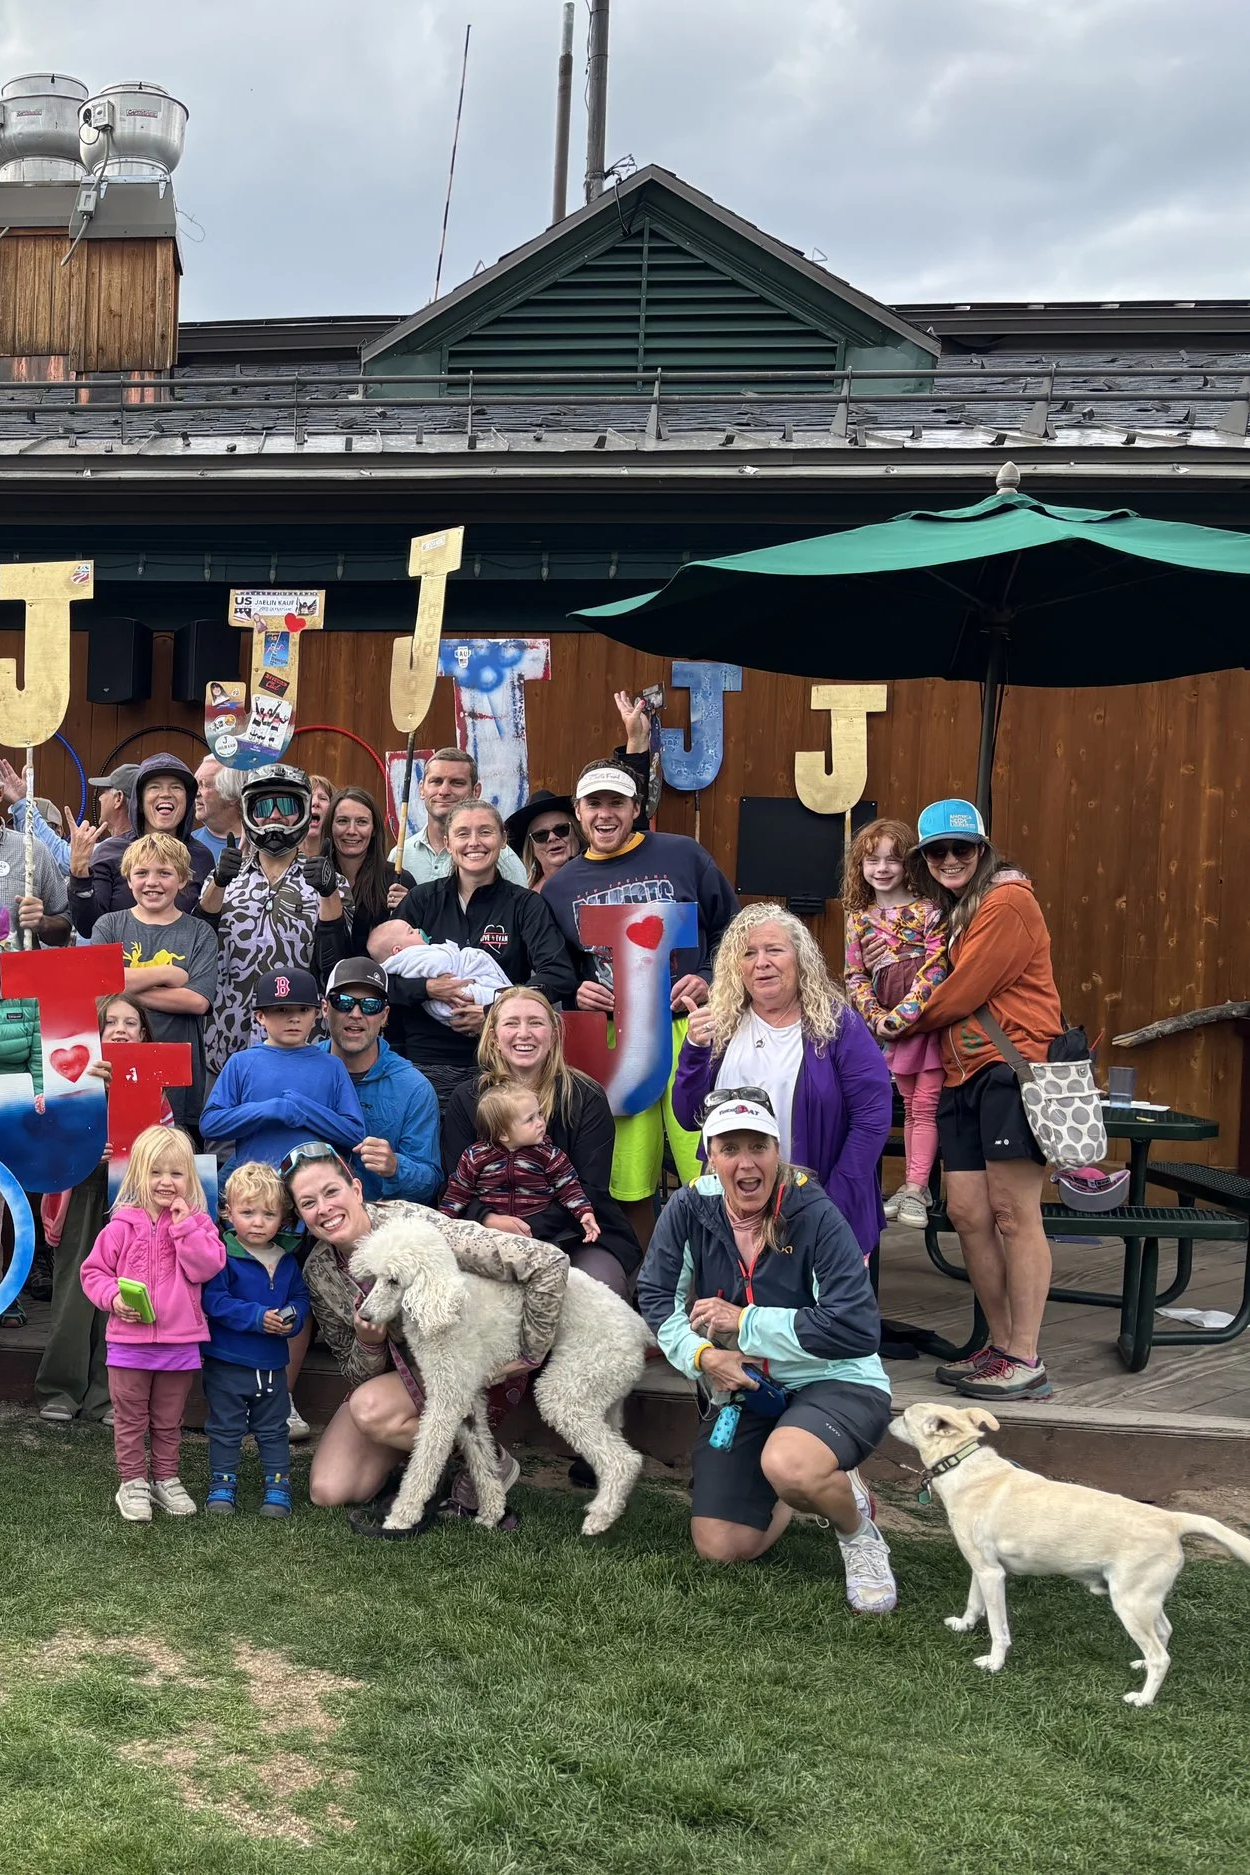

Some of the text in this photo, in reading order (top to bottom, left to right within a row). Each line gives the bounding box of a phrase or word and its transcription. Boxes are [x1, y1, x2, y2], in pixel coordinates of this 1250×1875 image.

[235, 596, 252, 605] US
[795, 684, 887, 814] J
[274, 976, 291, 997] B
[563, 902, 699, 1117] J
